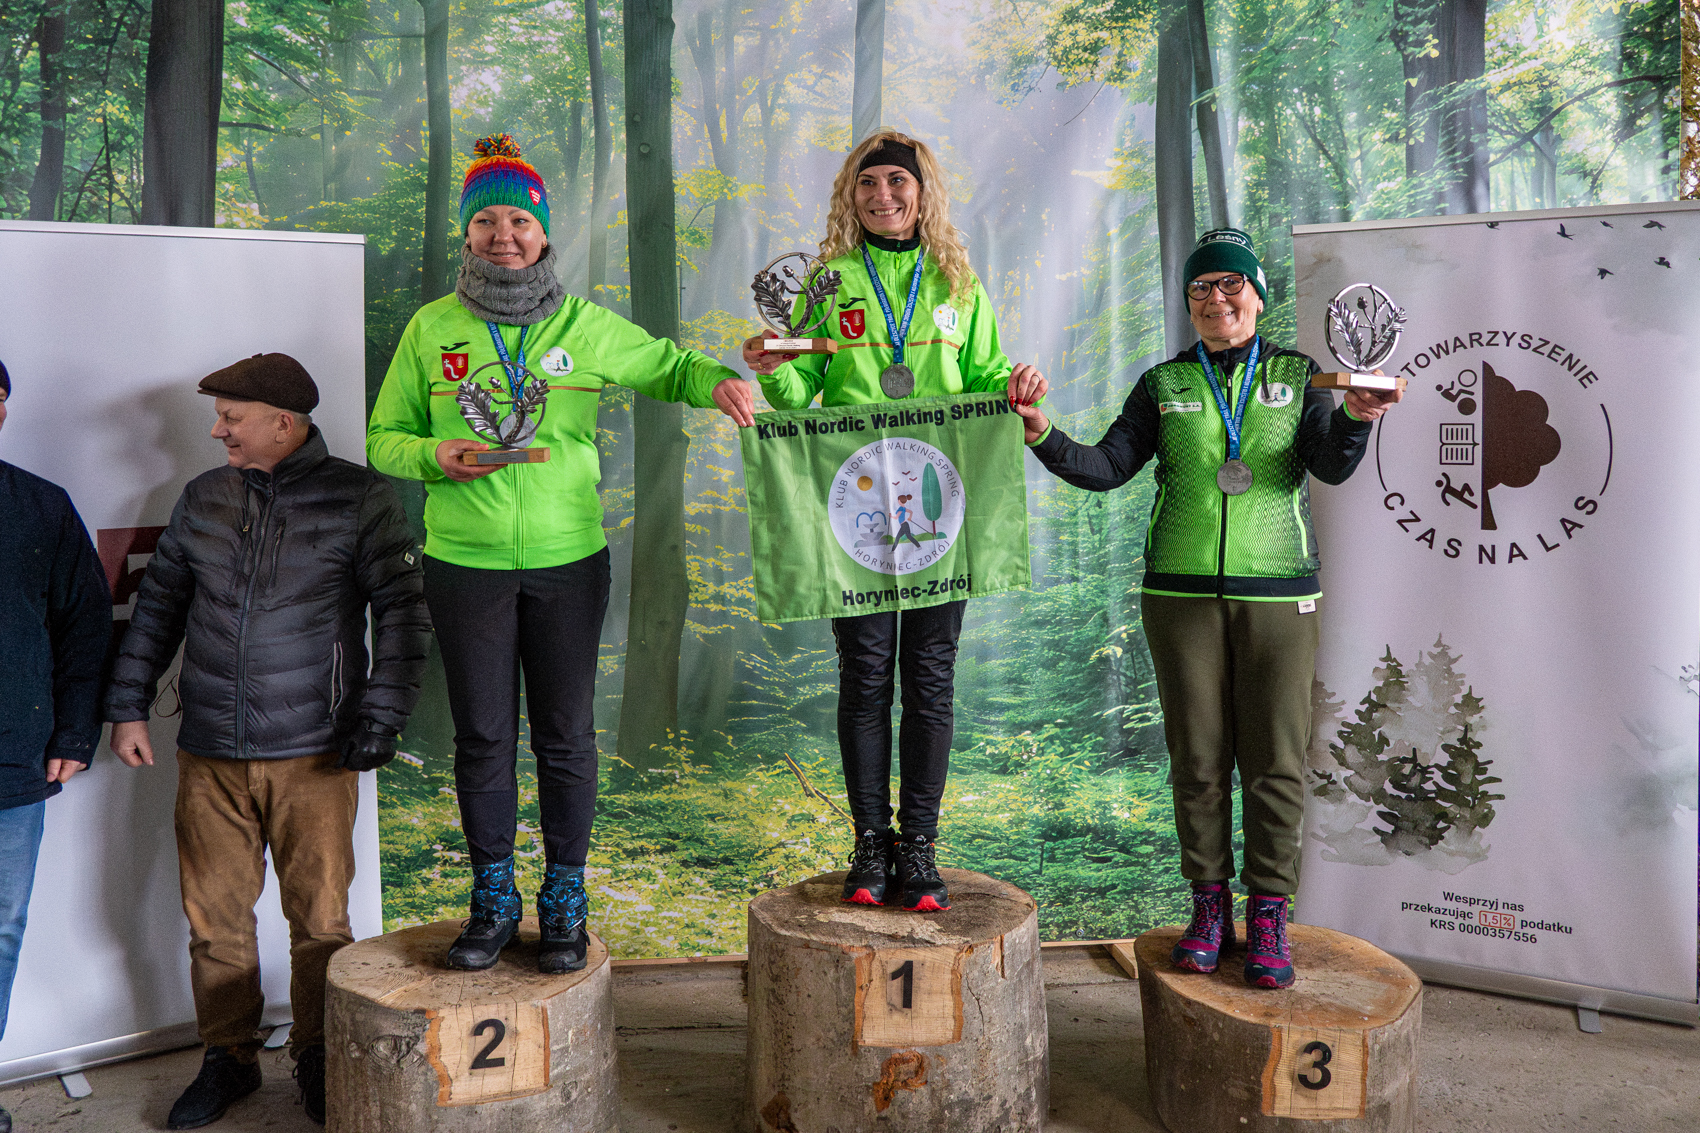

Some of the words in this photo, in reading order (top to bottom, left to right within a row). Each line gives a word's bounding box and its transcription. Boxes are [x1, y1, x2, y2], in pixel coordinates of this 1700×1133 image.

[1395, 331, 1599, 389] TOWARZYSZENIE
[757, 420, 798, 440] Klub
[804, 416, 865, 436] Nordic
[870, 409, 945, 430] Walking
[835, 479, 848, 508] KLUB
[847, 445, 883, 478] NORDIC
[884, 442, 936, 461] WALKING
[935, 458, 960, 498] SPRING
[1384, 492, 1462, 558] CZAS
[1478, 542, 1528, 564] NA
[1537, 496, 1598, 552] LAS
[854, 539, 950, 571] HORYNIEC-ZDRÓJ
[842, 574, 972, 607] Horyniec-Zdrój
[1401, 901, 1474, 919] przekazując
[1520, 918, 1573, 934] podatku
[1442, 891, 1499, 911] Wesprzyj
[1502, 901, 1524, 912] nas
[1430, 919, 1455, 931] KRS
[1458, 922, 1538, 944] 0000357556
[890, 960, 914, 1009] 1
[471, 1018, 506, 1070] 2
[1298, 1041, 1332, 1090] 3
